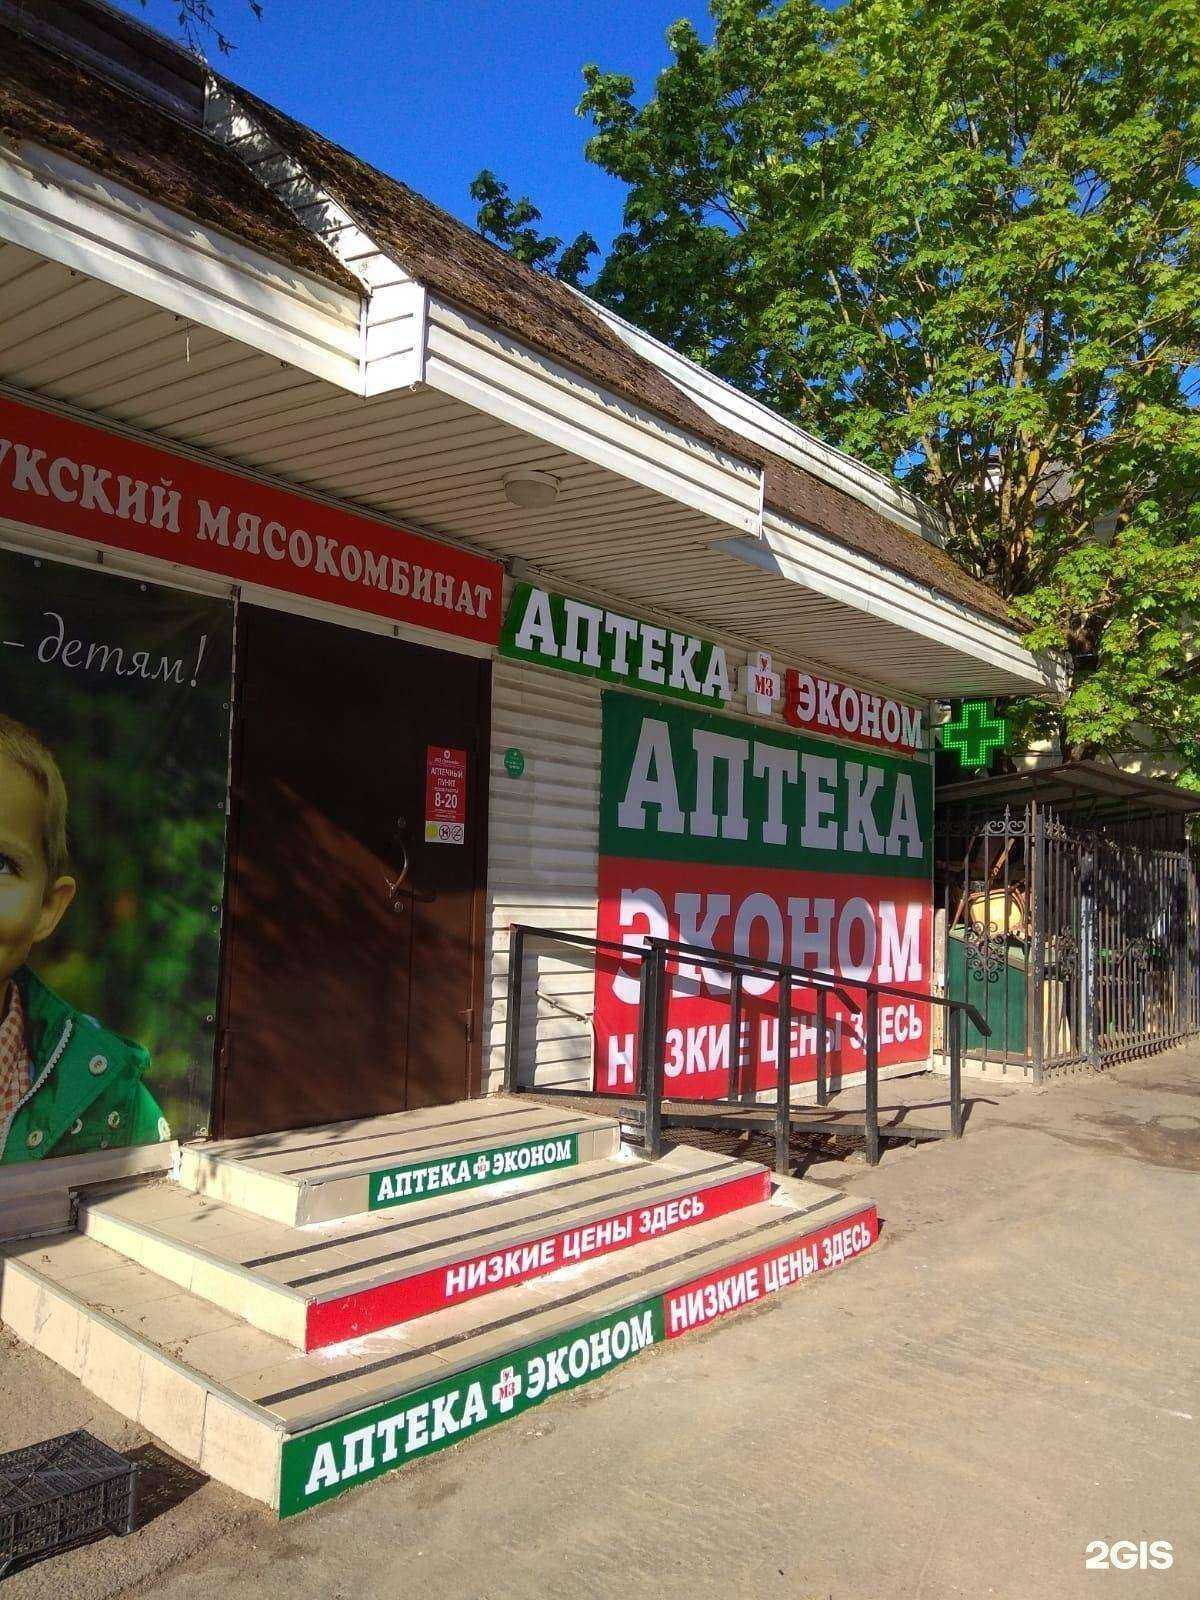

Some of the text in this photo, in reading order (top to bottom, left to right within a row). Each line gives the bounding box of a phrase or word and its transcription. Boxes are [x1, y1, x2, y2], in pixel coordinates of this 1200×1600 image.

[196, 499, 492, 620] МЯСОКОМБИНАТ
[37, 611, 208, 688] детям!
[514, 588, 732, 702] АПТЕКА
[795, 672, 924, 749] ЭКОНОМ
[434, 792, 458, 809] 8-20
[617, 717, 924, 859] АПТЕКА
[611, 887, 923, 1005] ЭКОНОМ
[607, 1021, 749, 1087] НЗКИЕ
[377, 1160, 472, 1201] АПТЕКА
[492, 1139, 572, 1175] ЭКОНОМ
[445, 1196, 705, 1298] НИЗКИЕ ЦЕНЫ ЗДЕСЬ
[670, 1221, 872, 1333] НИЗКИЕ ЦЕНЫ ЗДЕСЬ
[305, 1382, 488, 1496] АПТЕКА
[526, 1310, 655, 1399] ЭКОНОМ
